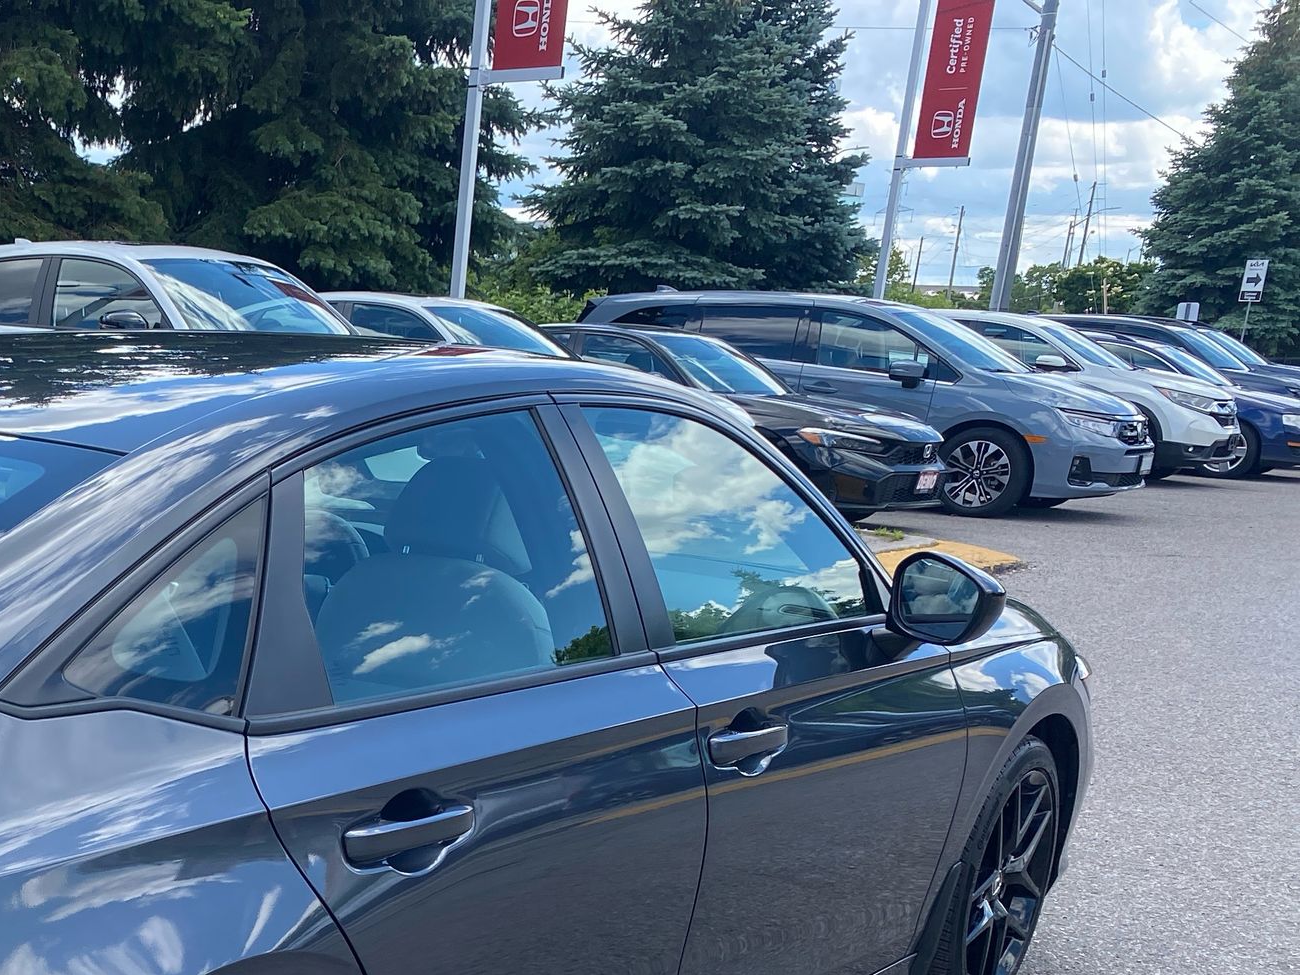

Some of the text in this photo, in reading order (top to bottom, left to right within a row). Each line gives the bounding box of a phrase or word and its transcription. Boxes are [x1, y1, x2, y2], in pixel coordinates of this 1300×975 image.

[946, 18, 964, 74] Certified
[959, 16, 975, 73] PRE-OWNED
[951, 98, 966, 148] HONDA
